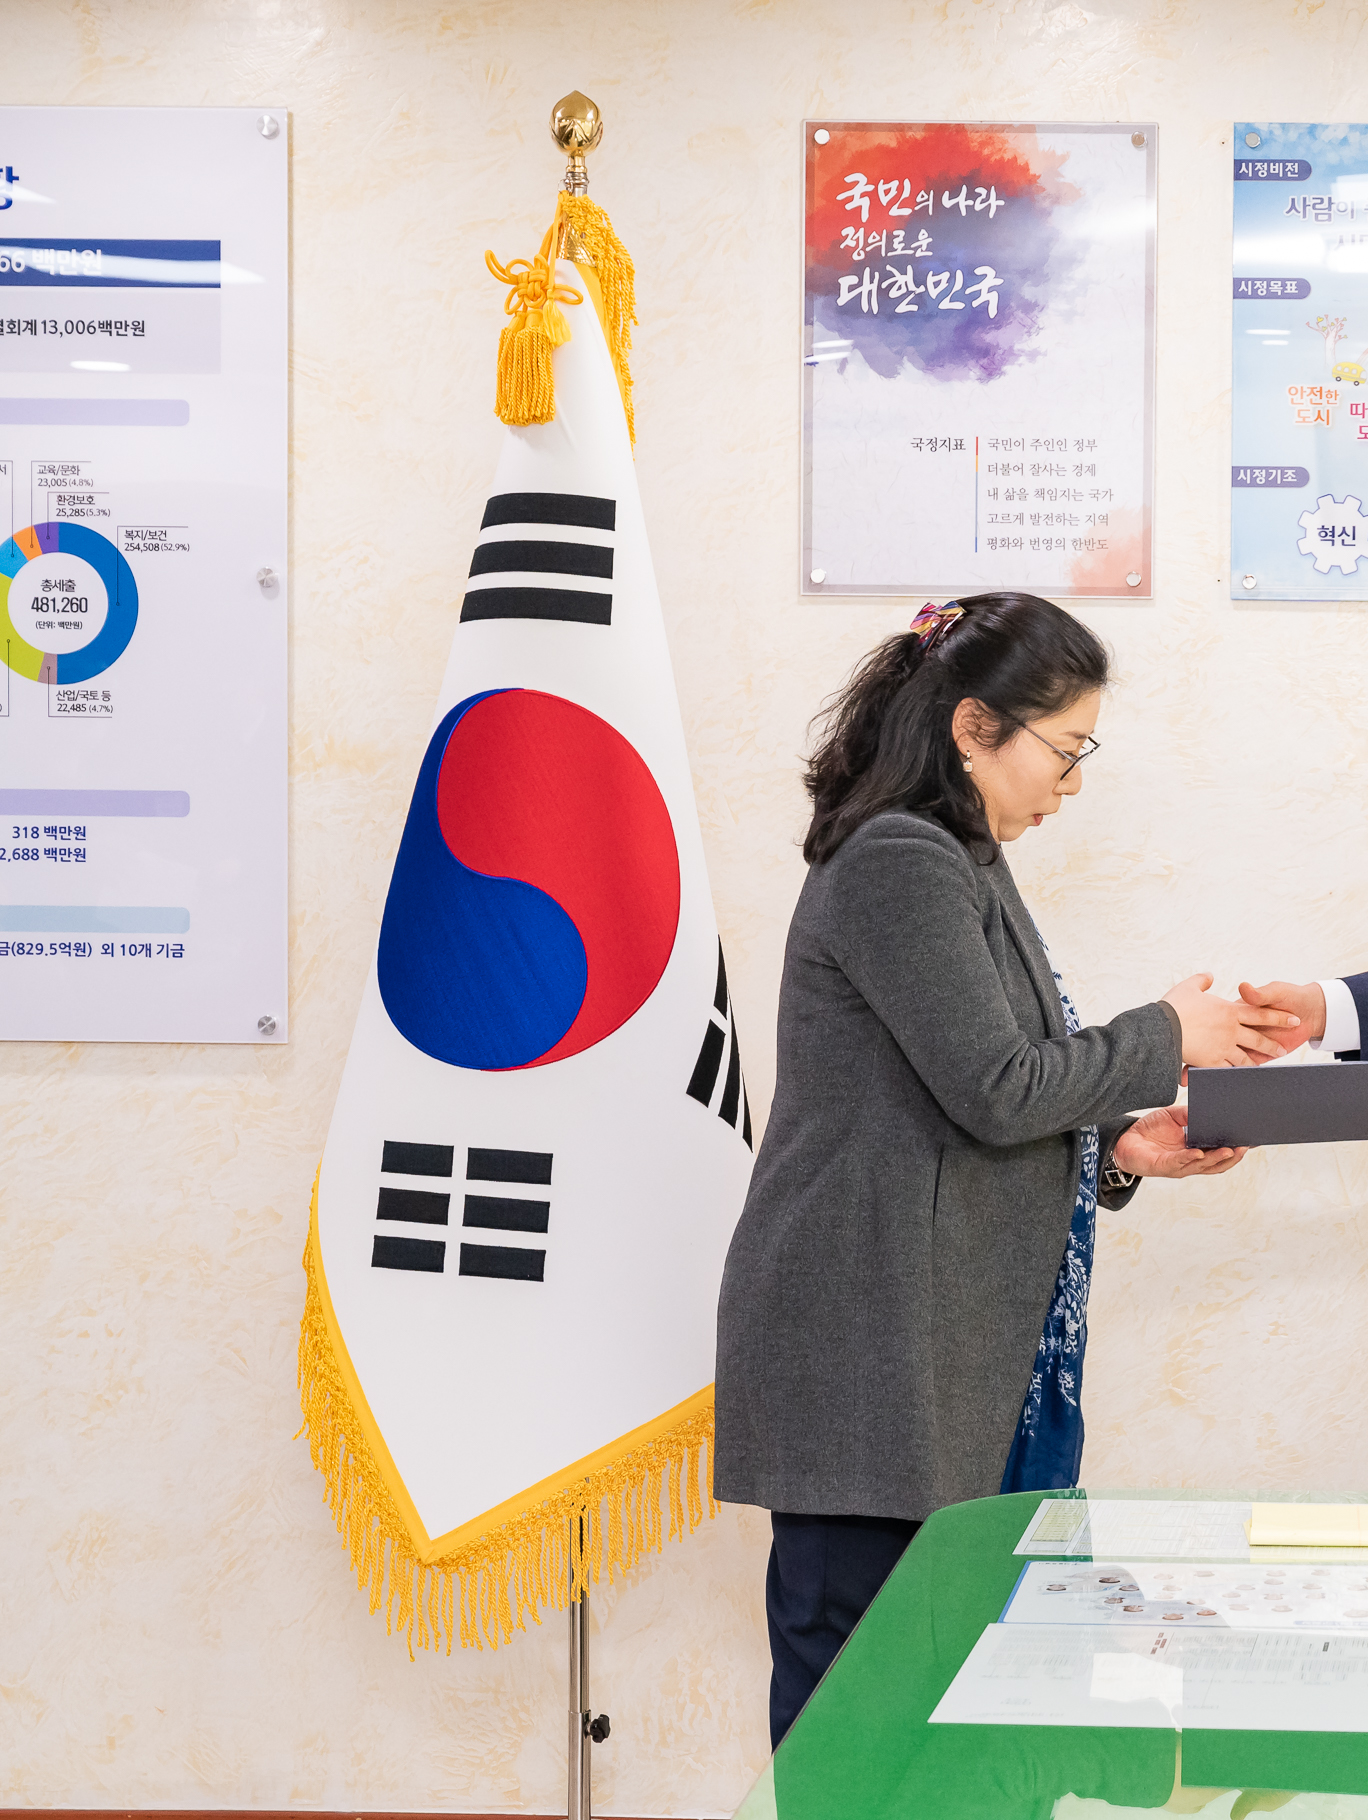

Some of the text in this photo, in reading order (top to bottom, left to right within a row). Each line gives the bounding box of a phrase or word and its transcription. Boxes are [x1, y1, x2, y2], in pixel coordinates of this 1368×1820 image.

[1238, 162, 1300, 179] 시정비전
[836, 172, 1005, 222] 국민의 나라
[1285, 196, 1355, 222] 사람이
[840, 226, 933, 260] 정의로운
[32, 249, 102, 275] 백만원
[836, 264, 1004, 317] 대한민국
[1238, 280, 1299, 296] 시정목표
[1288, 385, 1339, 405] 안전한
[1295, 408, 1330, 426] 도시
[910, 437, 966, 453] 국정지표
[988, 438, 1098, 452] 국민이 주인인 정부
[37, 464, 81, 476] 교육/문화
[988, 463, 1096, 477] 더불어 잘사는 경제
[1237, 468, 1297, 484] 시정기조
[56, 494, 96, 506] 환경보호
[988, 487, 1114, 502] 내 삶을 책임지는 국가
[987, 512, 1109, 527] 고르게 발전하는 지역
[124, 529, 167, 541] 복지/보건
[1317, 525, 1356, 547] 혁신
[987, 537, 1109, 551] 평화와 번영의 한반도
[41, 579, 76, 593] 총세출
[31, 597, 88, 614] 481,260
[35, 621, 83, 630] (단위: 백만원)
[56, 689, 111, 702] 산업/국토 등
[57, 703, 87, 714] 22,485
[12, 825, 87, 841] 318 백만원
[44, 847, 87, 863] 백만원
[100, 942, 114, 957] 외
[120, 943, 152, 958] 10개
[156, 943, 186, 959] 기금
